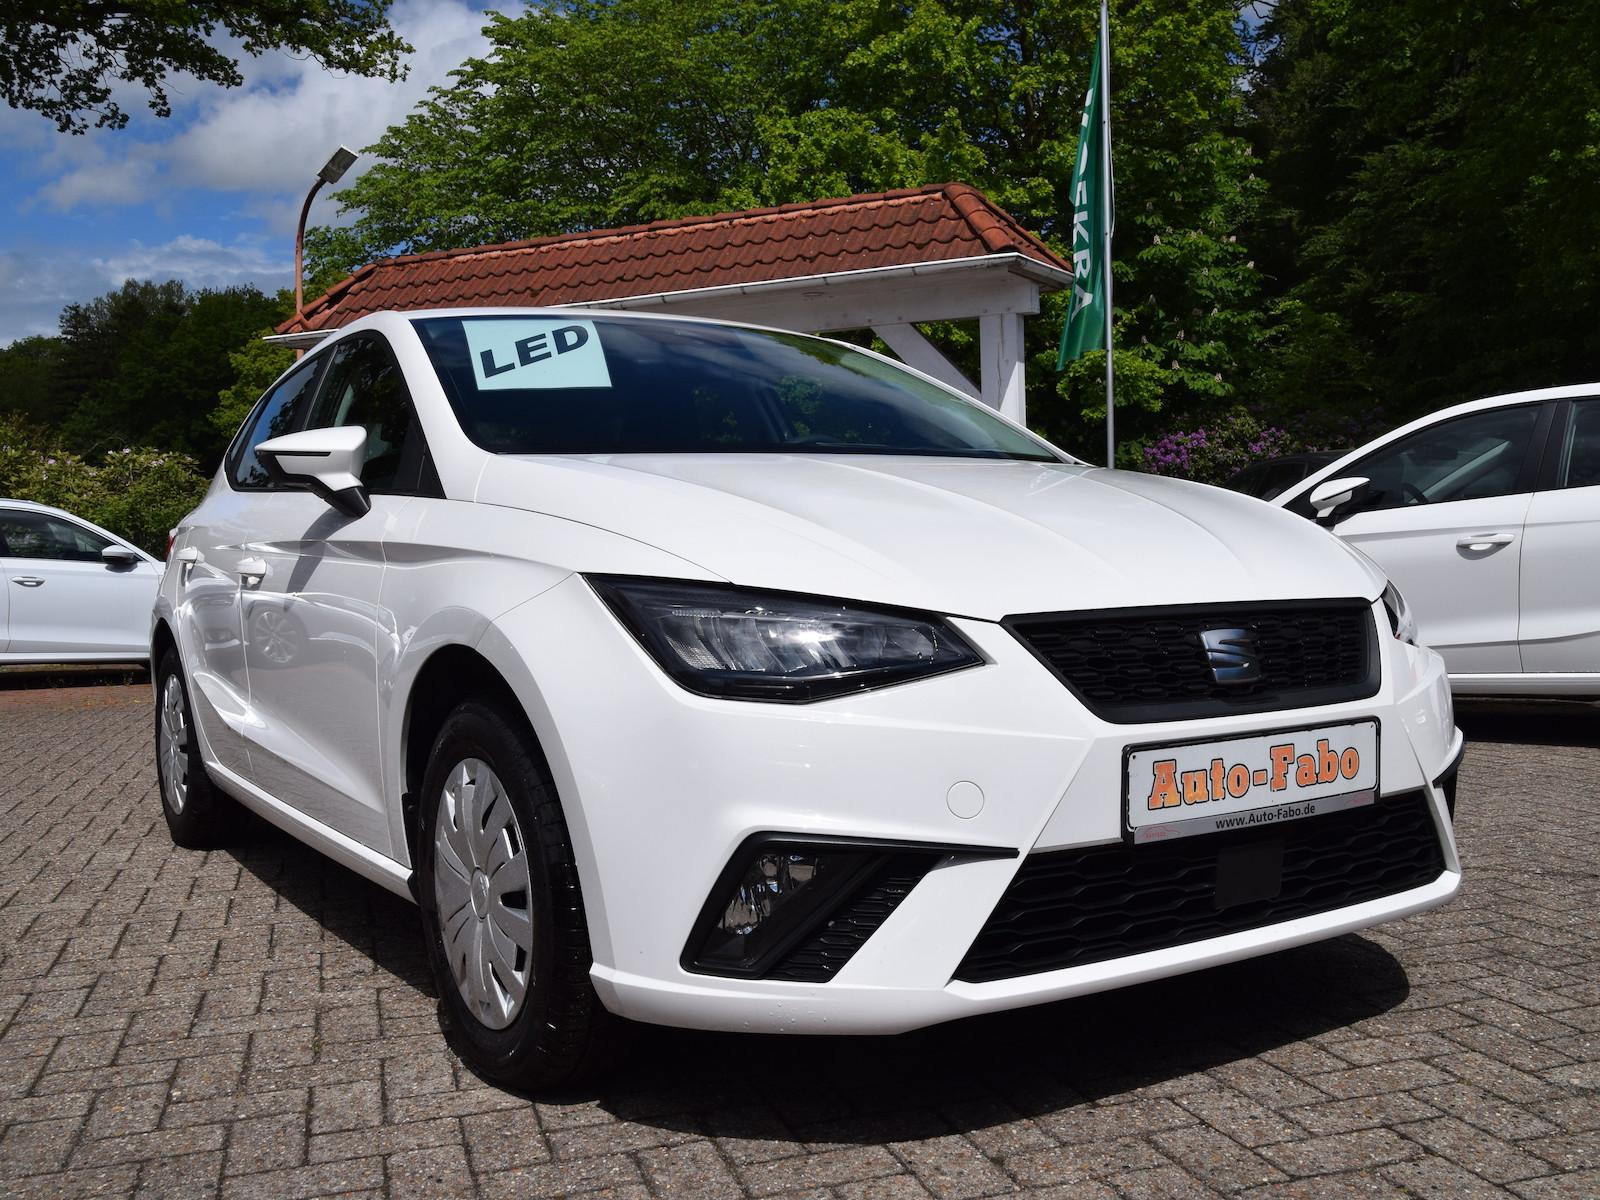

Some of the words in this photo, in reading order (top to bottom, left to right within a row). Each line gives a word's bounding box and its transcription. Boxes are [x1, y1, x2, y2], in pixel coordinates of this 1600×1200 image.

[480, 325, 589, 379] LED
[1148, 739, 1360, 810] Auto-Fabo
[1215, 803, 1316, 830] www.Auto-Fabo.de
